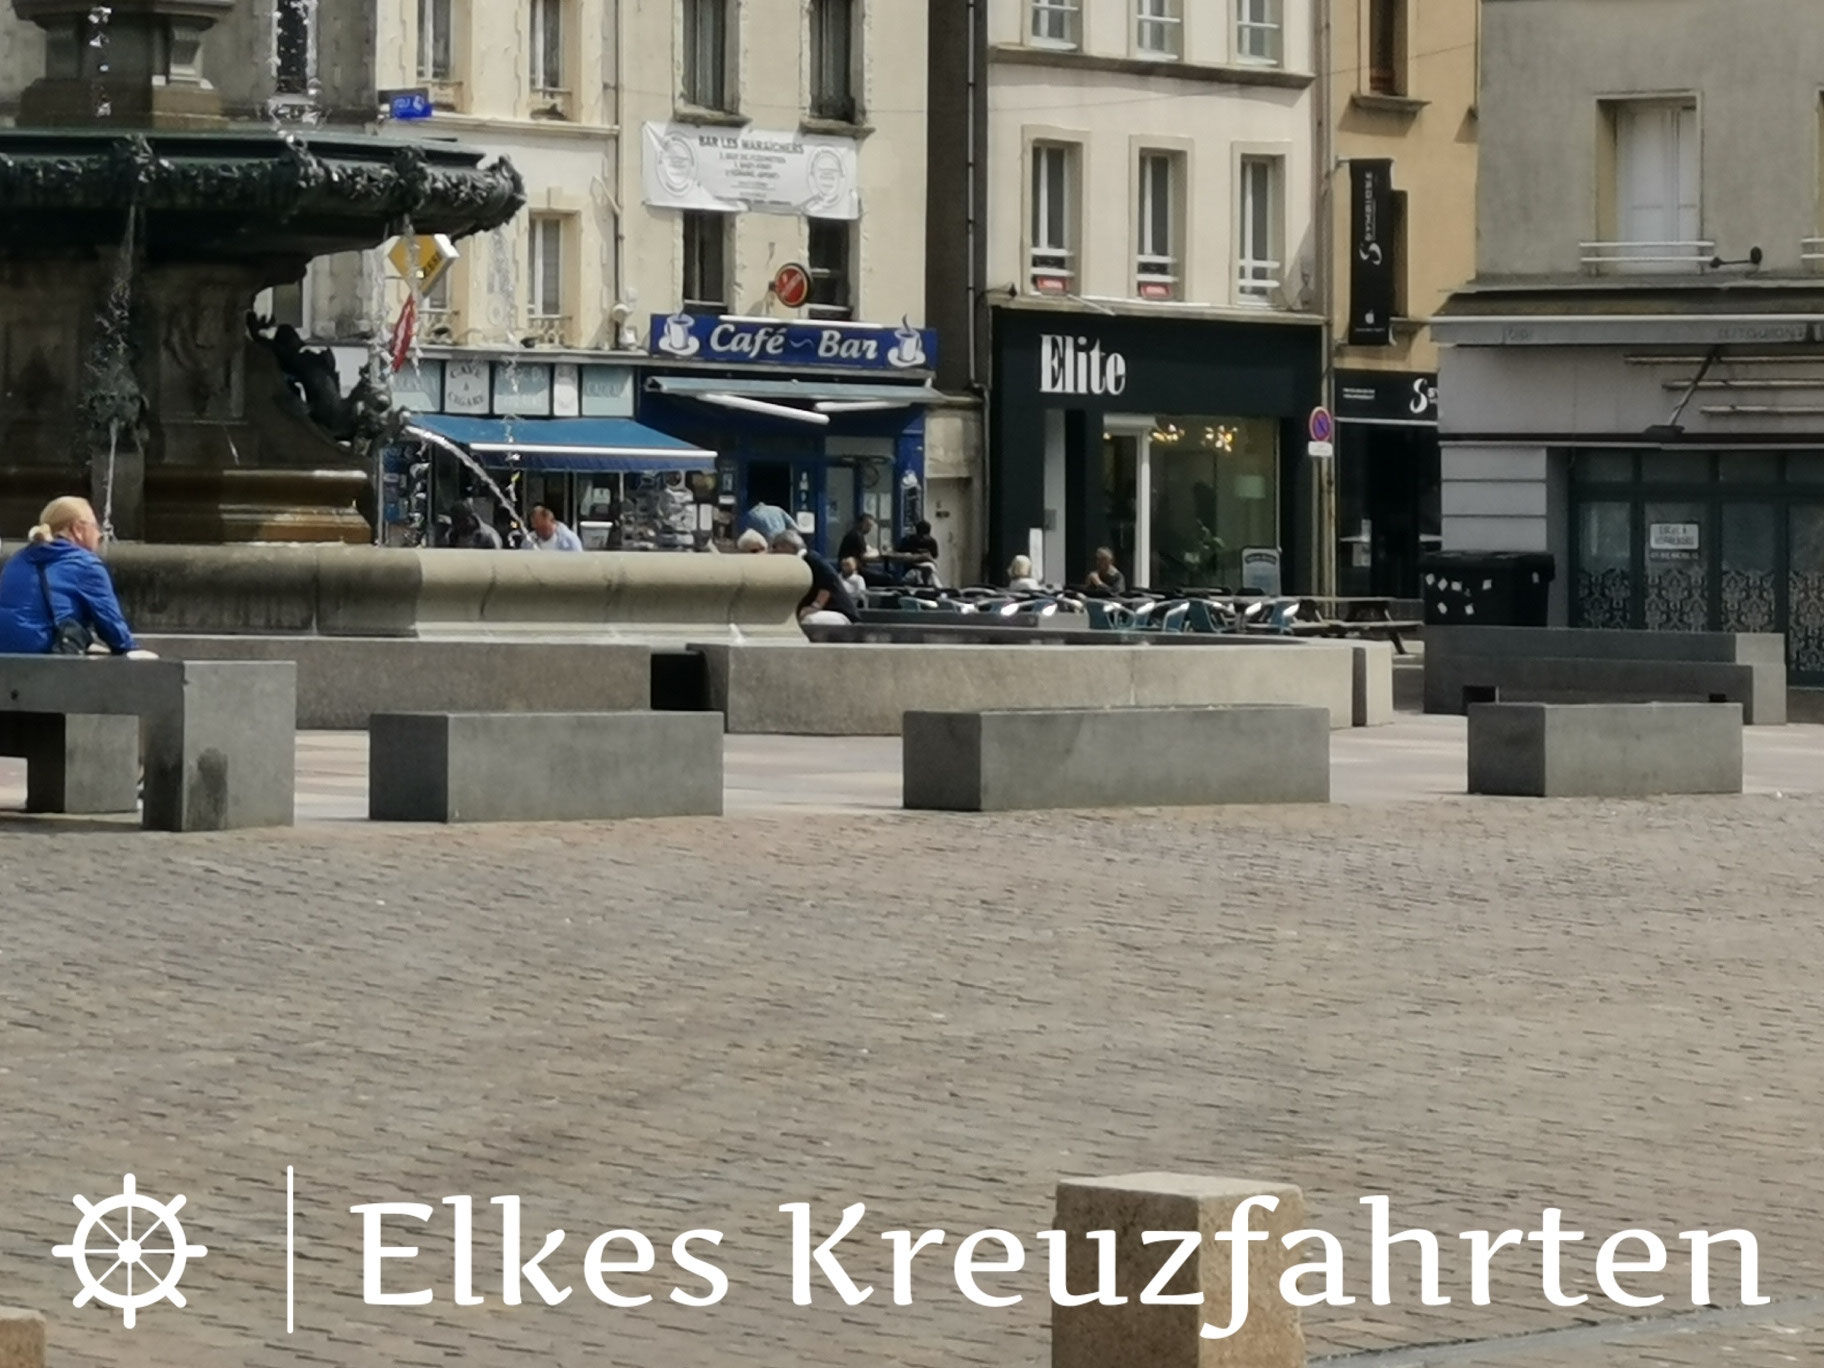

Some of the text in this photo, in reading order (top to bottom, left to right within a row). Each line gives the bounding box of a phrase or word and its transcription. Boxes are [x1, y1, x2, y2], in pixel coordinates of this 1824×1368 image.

[698, 135, 718, 147] BAR
[721, 136, 738, 149] LES
[709, 323, 879, 360] Café Bar
[1039, 333, 1126, 396] Elite
